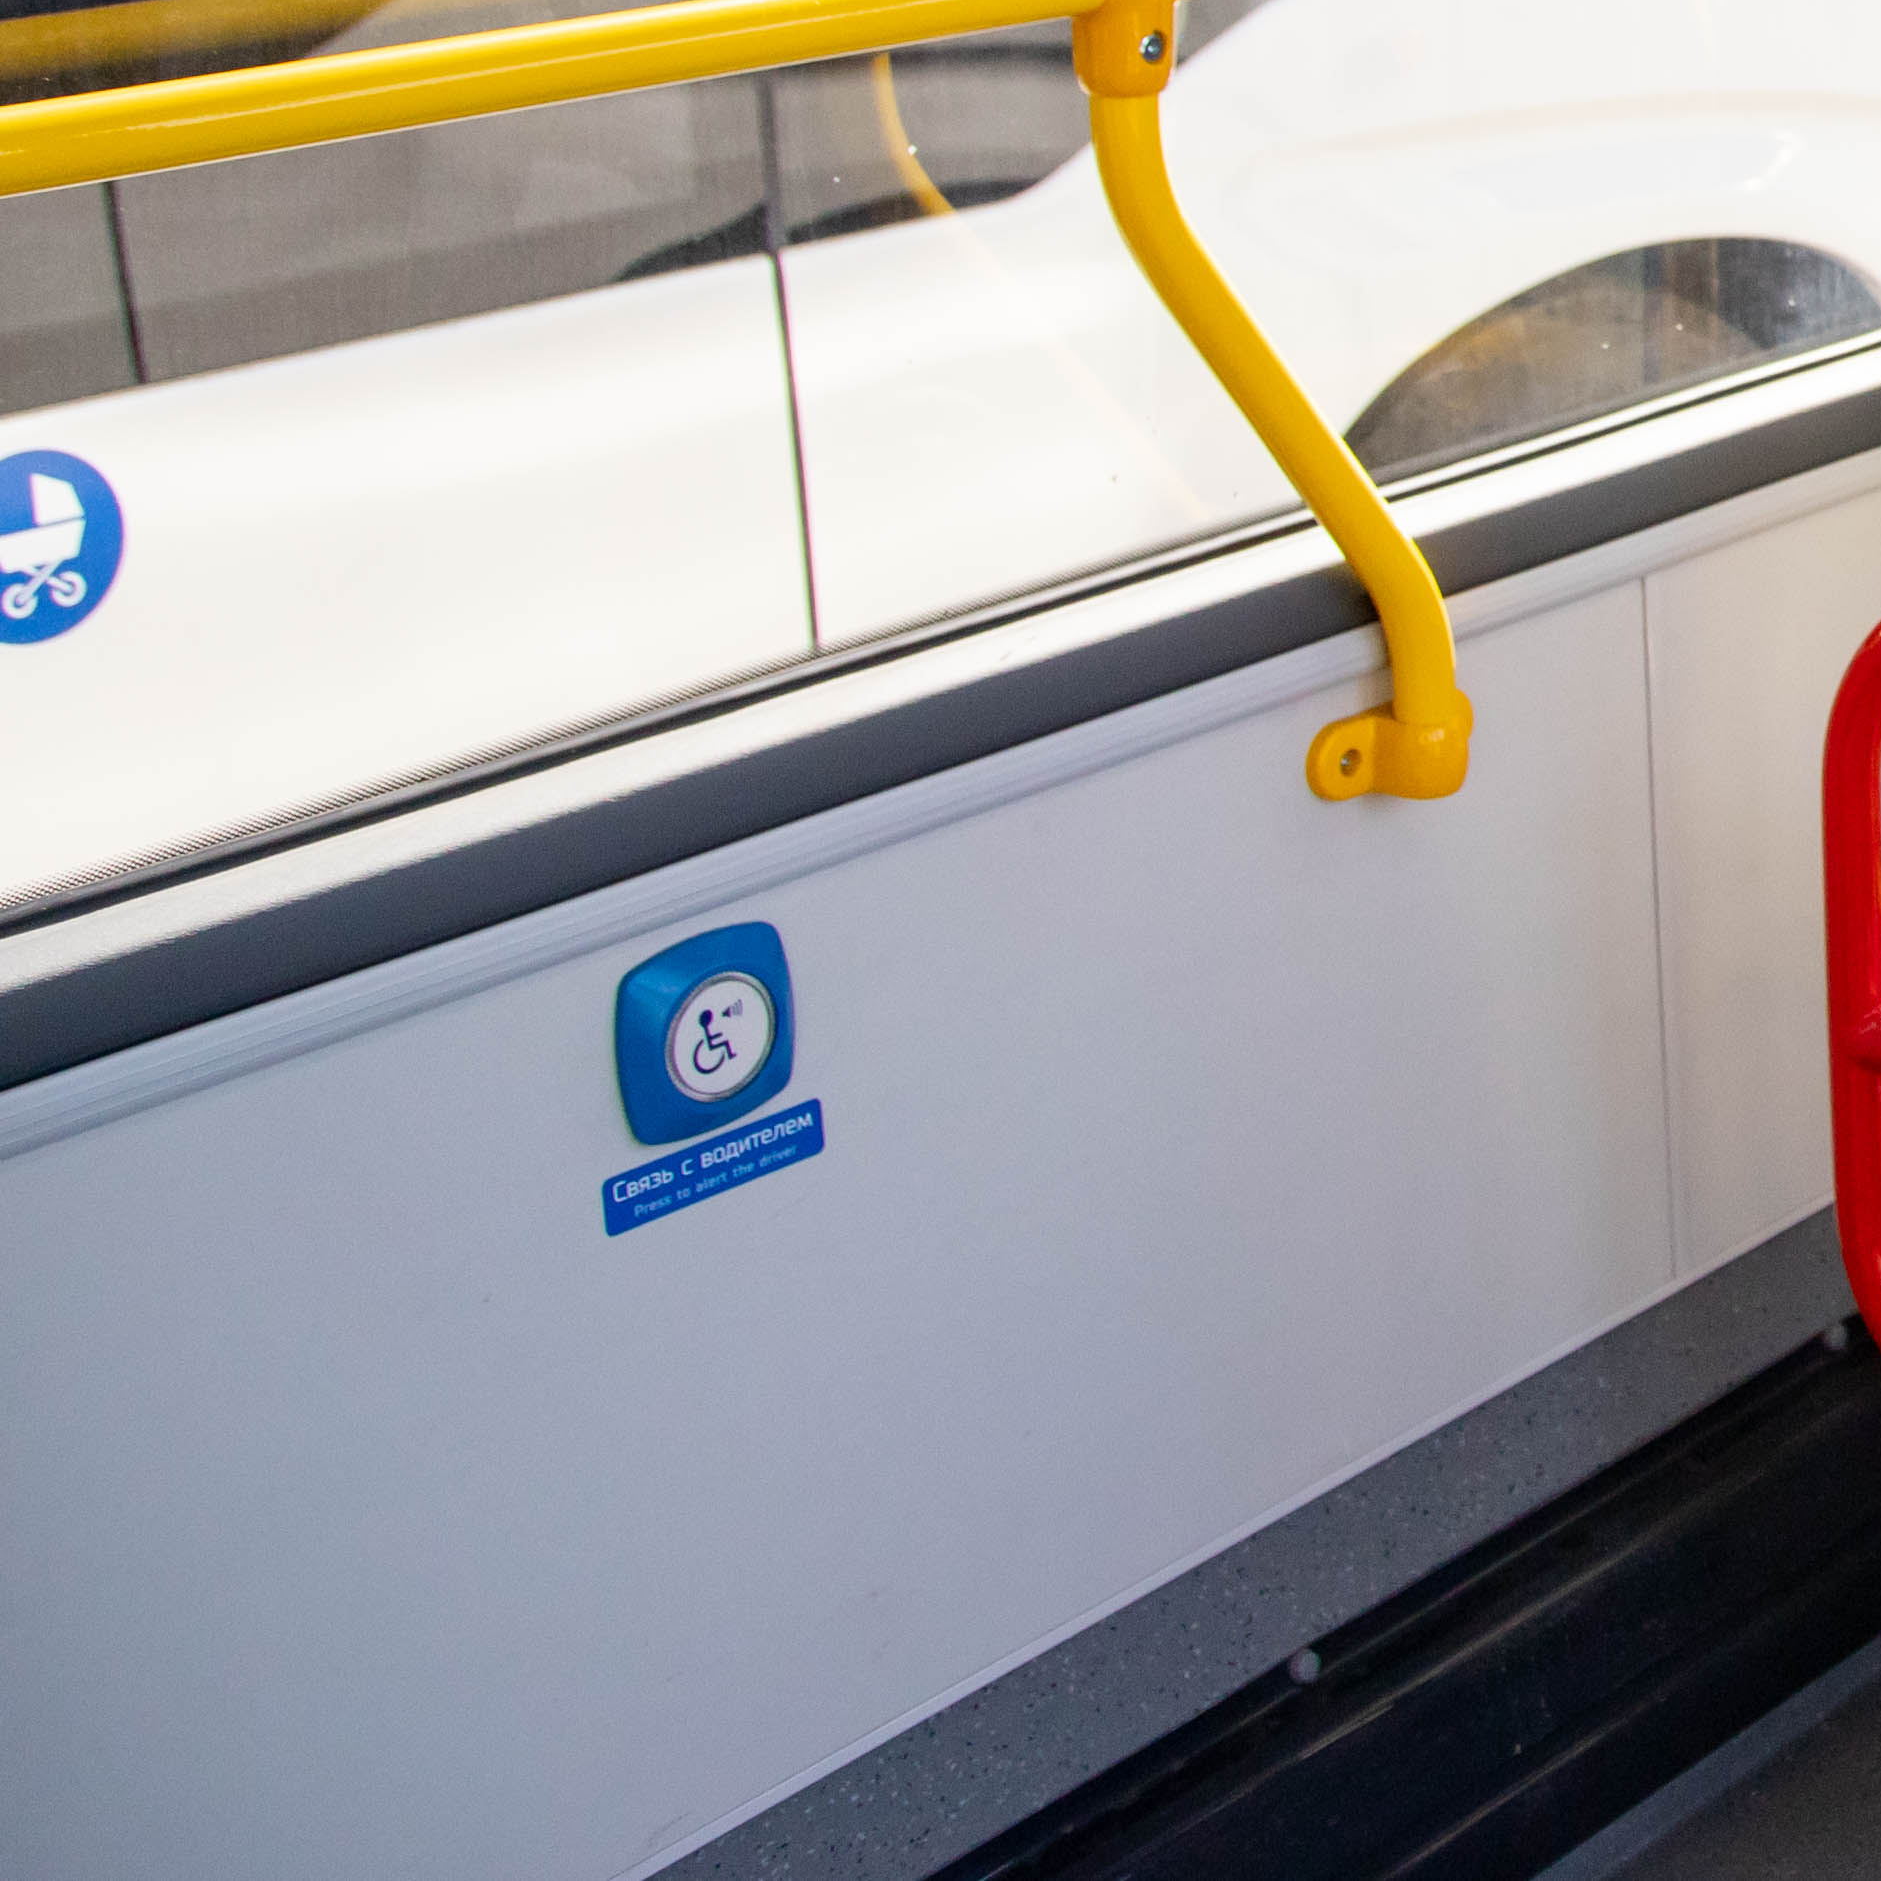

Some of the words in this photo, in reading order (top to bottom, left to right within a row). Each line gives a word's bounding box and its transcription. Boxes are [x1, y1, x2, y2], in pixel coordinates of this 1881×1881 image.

[612, 1170, 674, 1203] Связь
[681, 1159, 694, 1176] с
[700, 1112, 814, 1169] водителем
[634, 1194, 673, 1218] Press
[676, 1186, 691, 1200] to
[696, 1171, 728, 1194] alert
[732, 1160, 755, 1179] the
[759, 1144, 798, 1168] driver
